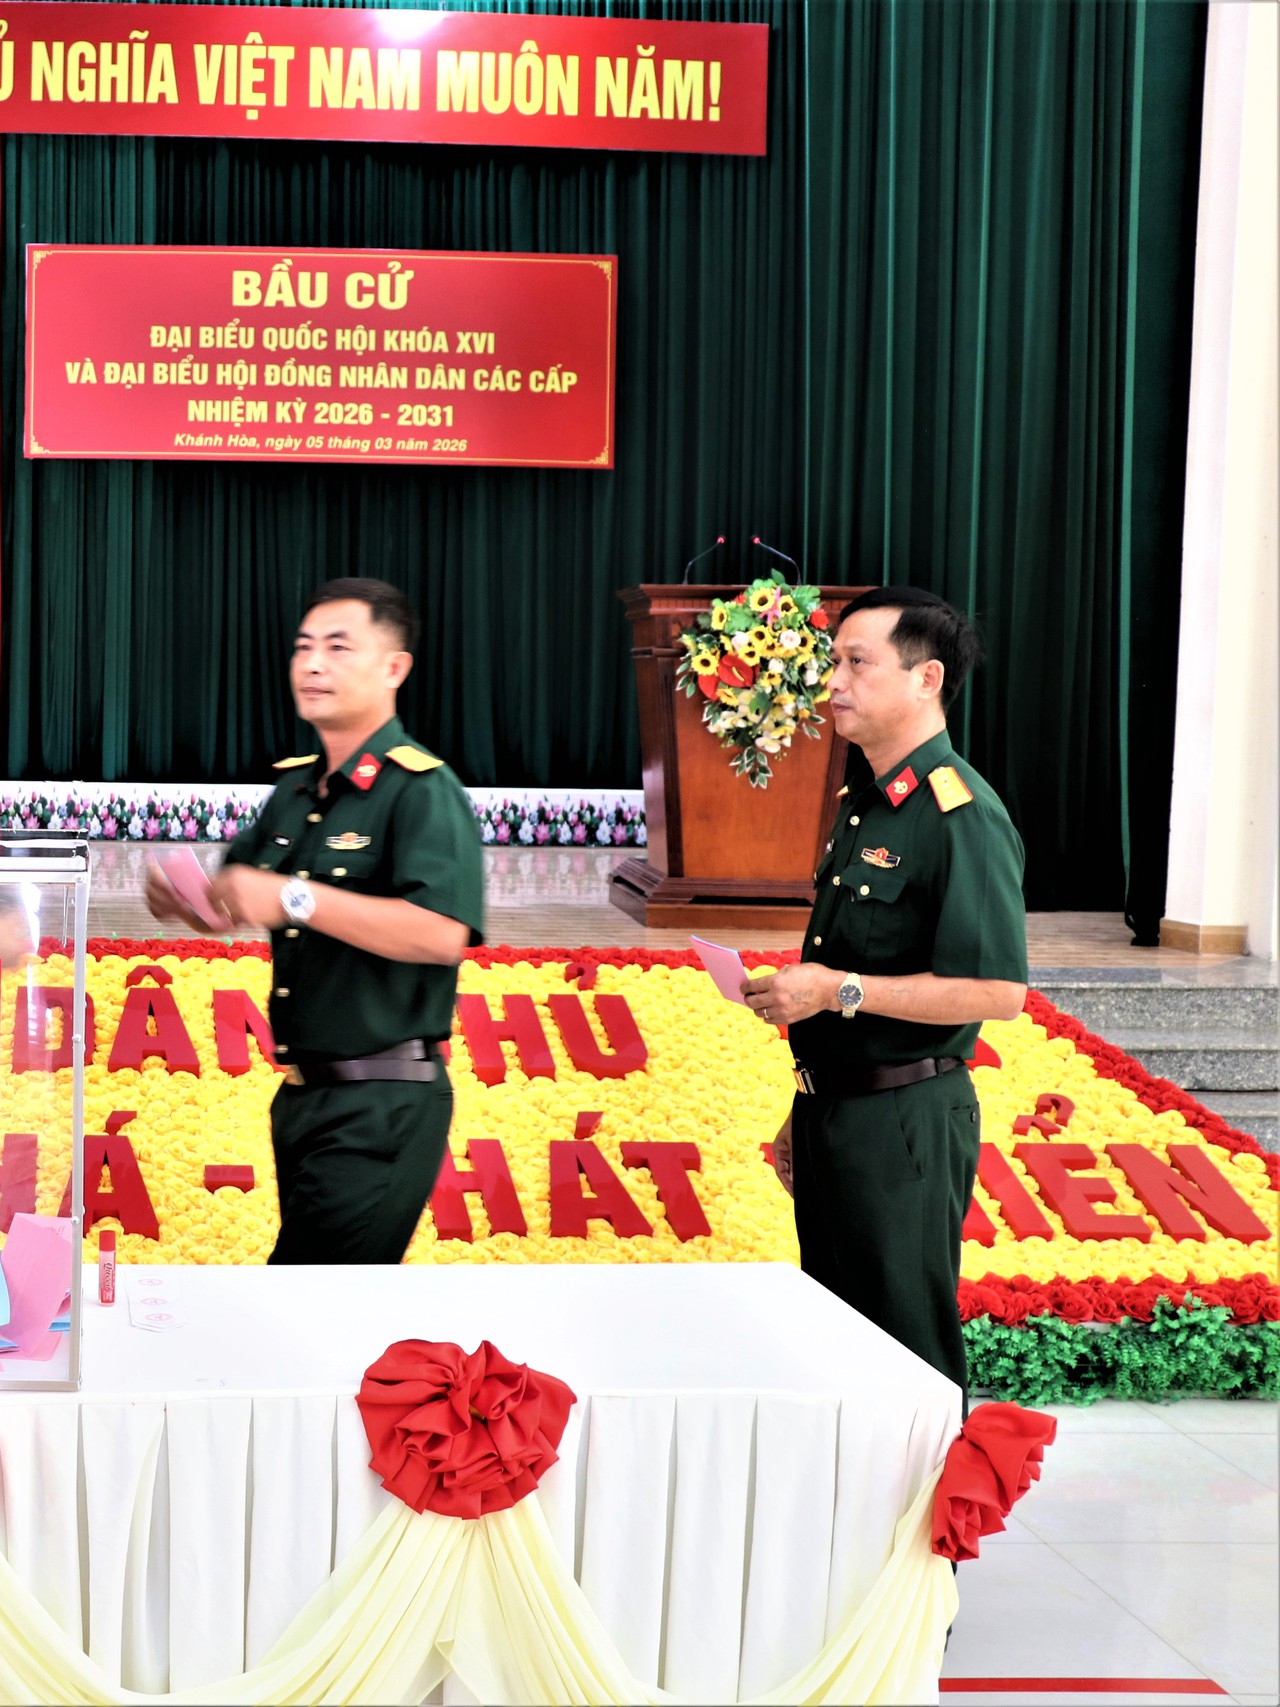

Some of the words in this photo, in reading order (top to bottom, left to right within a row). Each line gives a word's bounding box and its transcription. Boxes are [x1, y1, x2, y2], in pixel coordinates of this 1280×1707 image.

[30, 29, 179, 104] NGHĨA
[193, 31, 296, 120] VIỆT
[308, 46, 421, 110] NAM
[436, 39, 580, 117] MUÔN
[594, 44, 722, 122] NĂM!
[232, 257, 329, 308] BẦU
[345, 260, 415, 310] CỬ
[150, 325, 192, 352] ĐẠI
[199, 318, 255, 349] BIỂU
[262, 321, 328, 352] QUỐC
[335, 325, 377, 355] HỘI
[383, 326, 449, 353] KHÓA
[457, 331, 495, 354] XVI
[65, 358, 97, 384] VÀ
[104, 362, 146, 389] ĐẠI
[153, 354, 209, 385] BIỂU
[216, 361, 258, 390] HỘI
[264, 357, 332, 387] ĐỒNG
[339, 363, 409, 388] NHÂN
[415, 365, 466, 390] DÂN
[473, 365, 522, 392] CÁC
[529, 364, 578, 394] CẤP
[187, 397, 269, 427] NHIỆM
[275, 397, 308, 424] KỲ
[314, 401, 374, 425] 2026
[397, 403, 454, 427] 2031
[174, 434, 223, 446] Khánh
[227, 434, 261, 450] Hòa,
[265, 436, 302, 451] ngày
[306, 435, 324, 448] 05
[328, 437, 371, 453] tháng
[375, 437, 393, 449] 03
[396, 439, 429, 450] năm
[432, 438, 468, 452] 2026
[440, 962, 649, 1086] HỦ
[429, 1111, 712, 1243] HÁT
